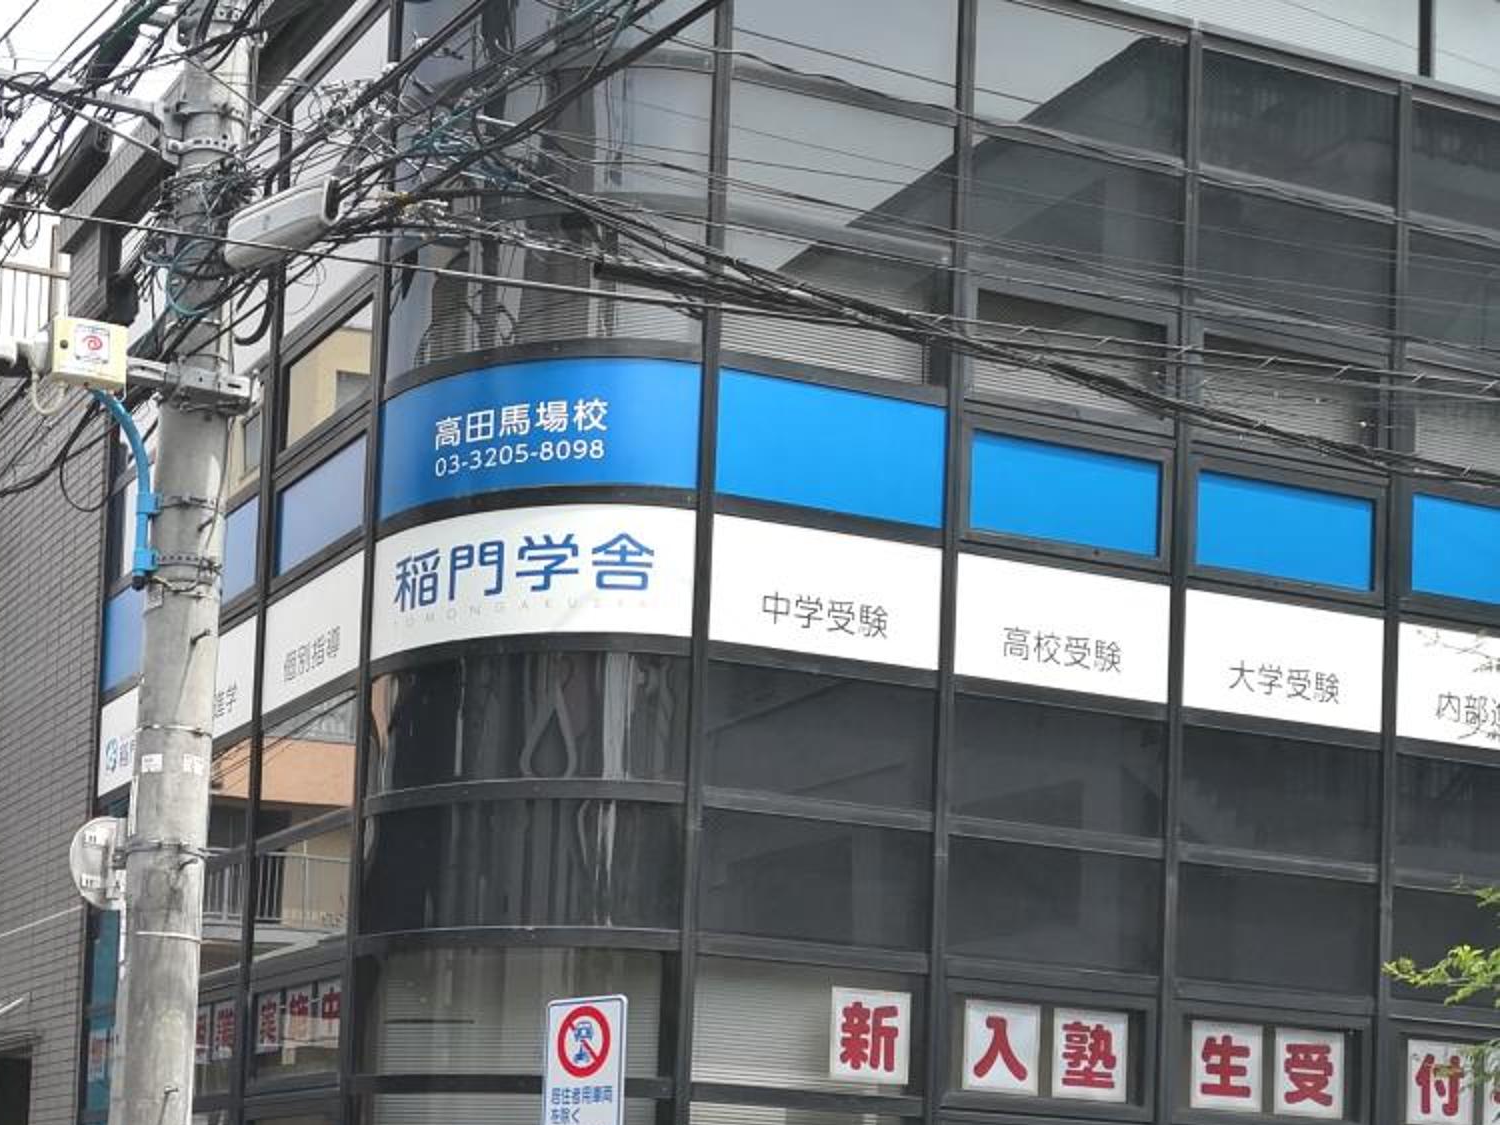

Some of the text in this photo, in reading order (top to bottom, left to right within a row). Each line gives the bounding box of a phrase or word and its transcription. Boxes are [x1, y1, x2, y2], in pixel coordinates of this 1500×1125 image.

[435, 397, 609, 450] 高田馬場校
[434, 439, 605, 477] 03-3205-8098
[394, 532, 656, 612] 稲門学舎
[761, 591, 889, 639] 中学受験
[1002, 625, 1124, 674] 高校受験
[1228, 660, 1341, 704] 大学受験
